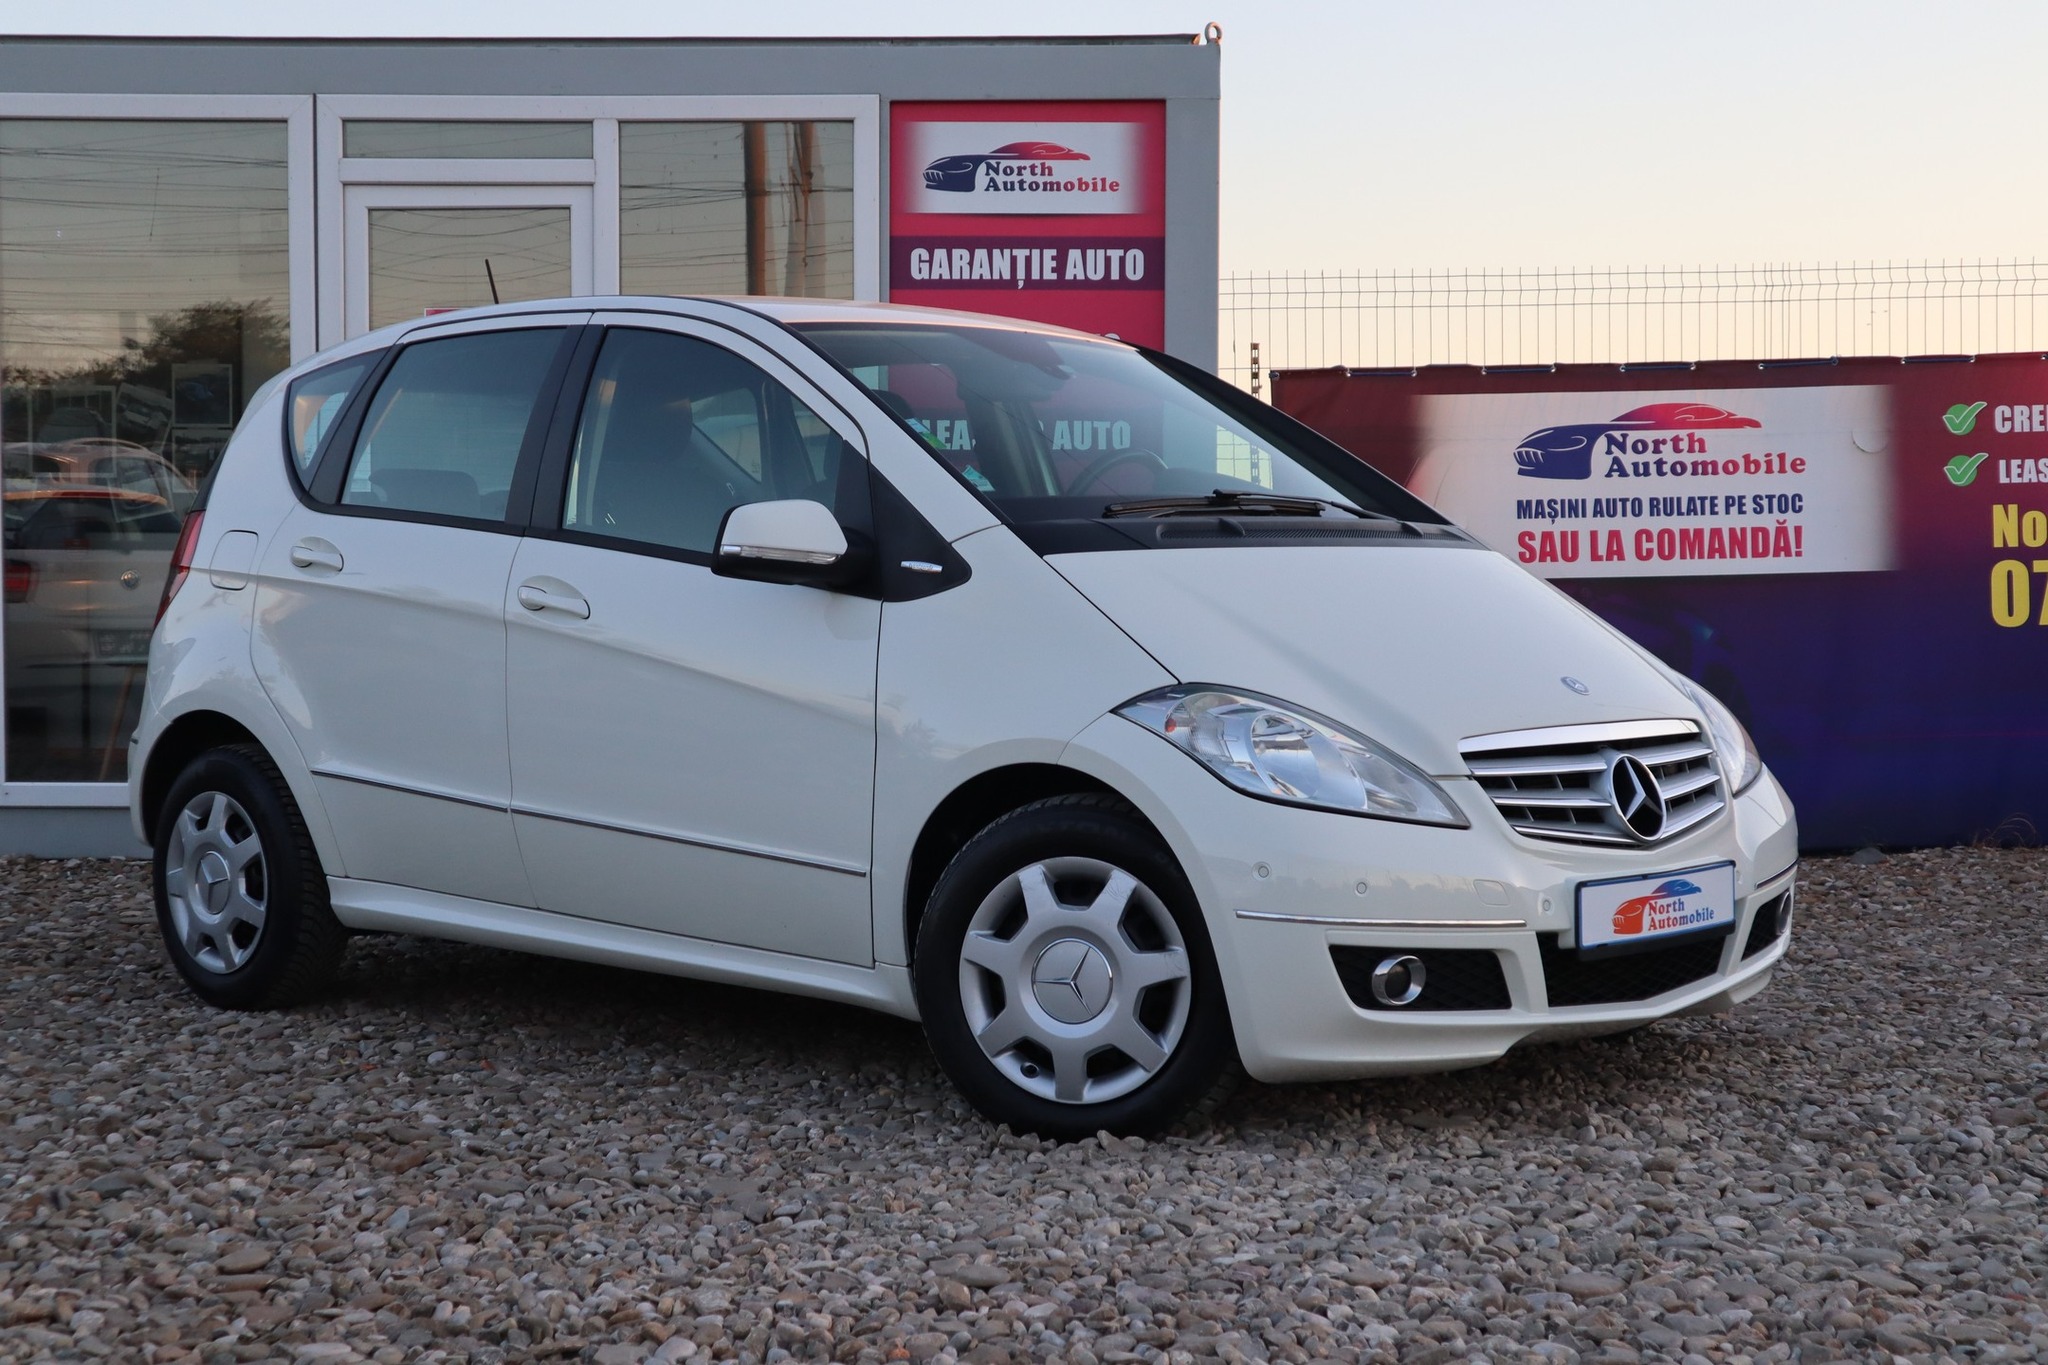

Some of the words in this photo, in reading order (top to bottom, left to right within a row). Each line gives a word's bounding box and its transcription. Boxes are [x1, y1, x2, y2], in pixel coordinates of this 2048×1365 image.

[984, 161, 1054, 177] North
[984, 177, 1120, 192] Automobile
[910, 248, 1058, 290] GARANȚIE
[1065, 248, 1145, 281] AUTO
[1994, 404, 2048, 434] CRE
[1052, 419, 1131, 450] AUTO
[1604, 431, 1708, 456] North
[1604, 452, 1807, 479] Automobile
[1516, 497, 1588, 525] MAȘINI
[1593, 496, 1644, 519] AUTO
[1649, 495, 1719, 518] RULATE
[1725, 494, 1747, 516] PE
[1752, 493, 1804, 515] STOC
[1518, 529, 1580, 564] SAU
[1589, 528, 1626, 562] LA
[1634, 518, 1804, 562] COMANDĂ!
[1648, 898, 1685, 916] North
[1648, 907, 1715, 931] Automobile
